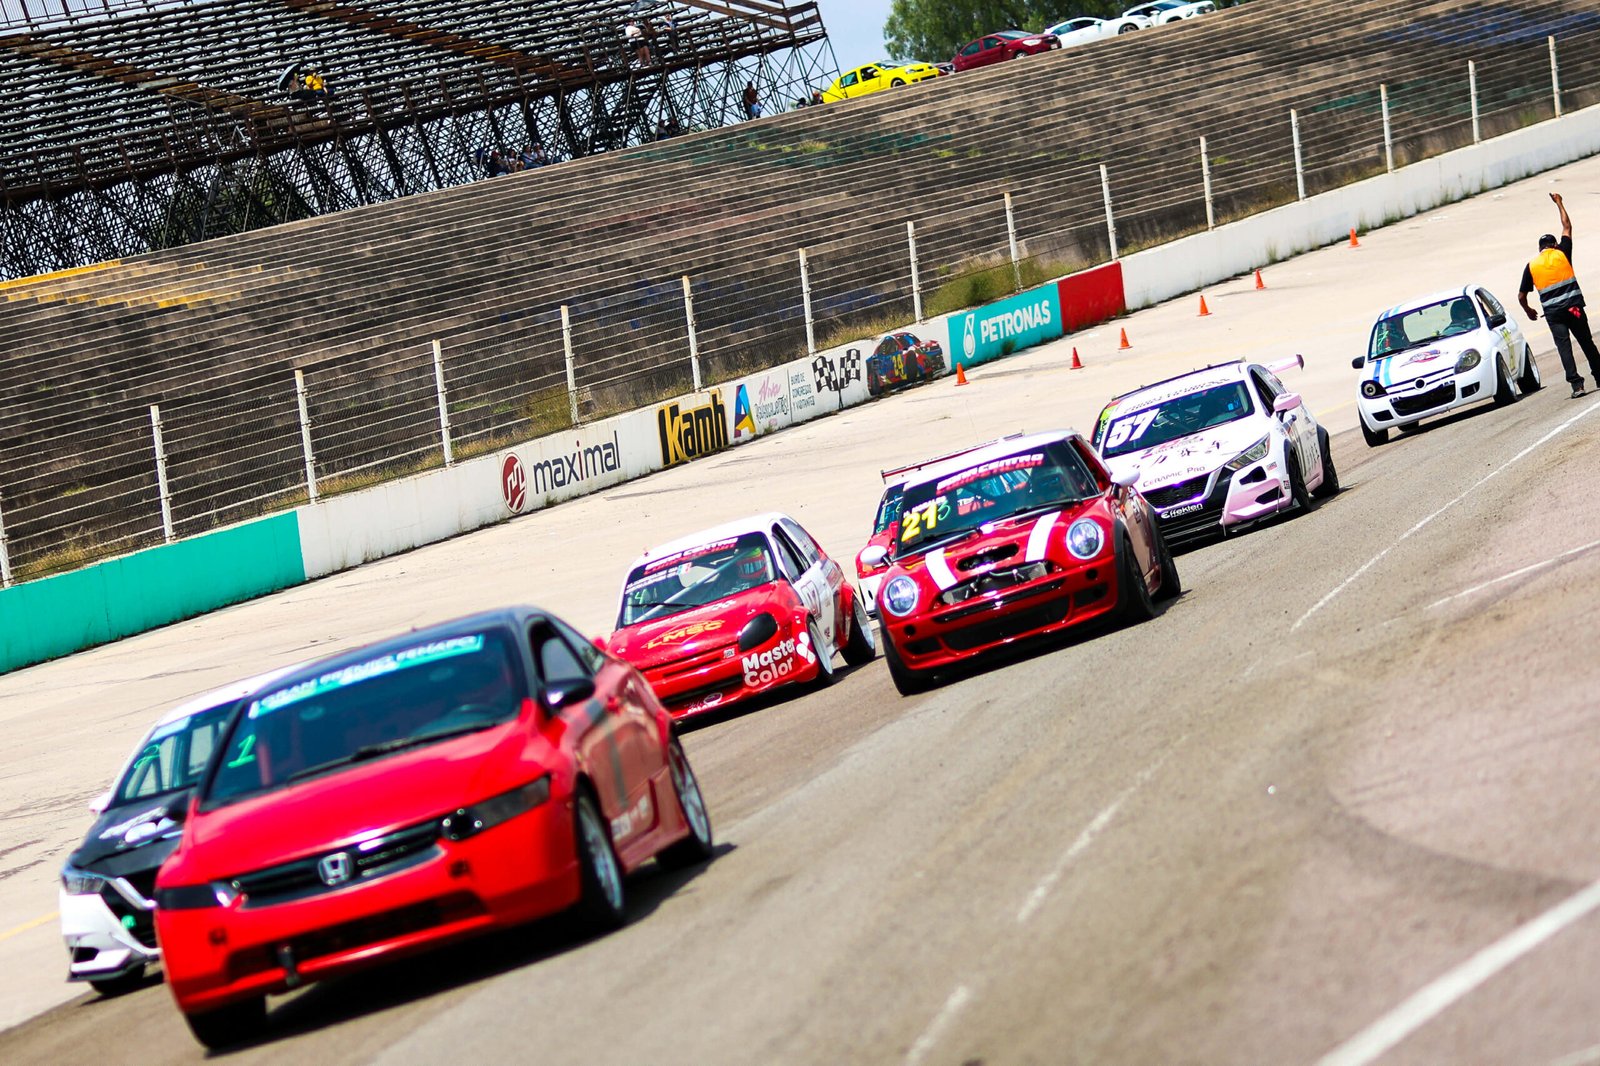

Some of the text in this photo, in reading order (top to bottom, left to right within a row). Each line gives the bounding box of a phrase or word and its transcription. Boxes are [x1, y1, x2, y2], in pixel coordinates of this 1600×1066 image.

[980, 300, 1051, 344] PETRONAS
[658, 388, 730, 467] Kamh
[1105, 408, 1160, 448] 57
[533, 430, 621, 494] maximal
[901, 502, 937, 542] 21
[742, 637, 796, 674] Master
[744, 656, 793, 687] Color
[133, 744, 161, 769] 2
[228, 734, 256, 768] 1
